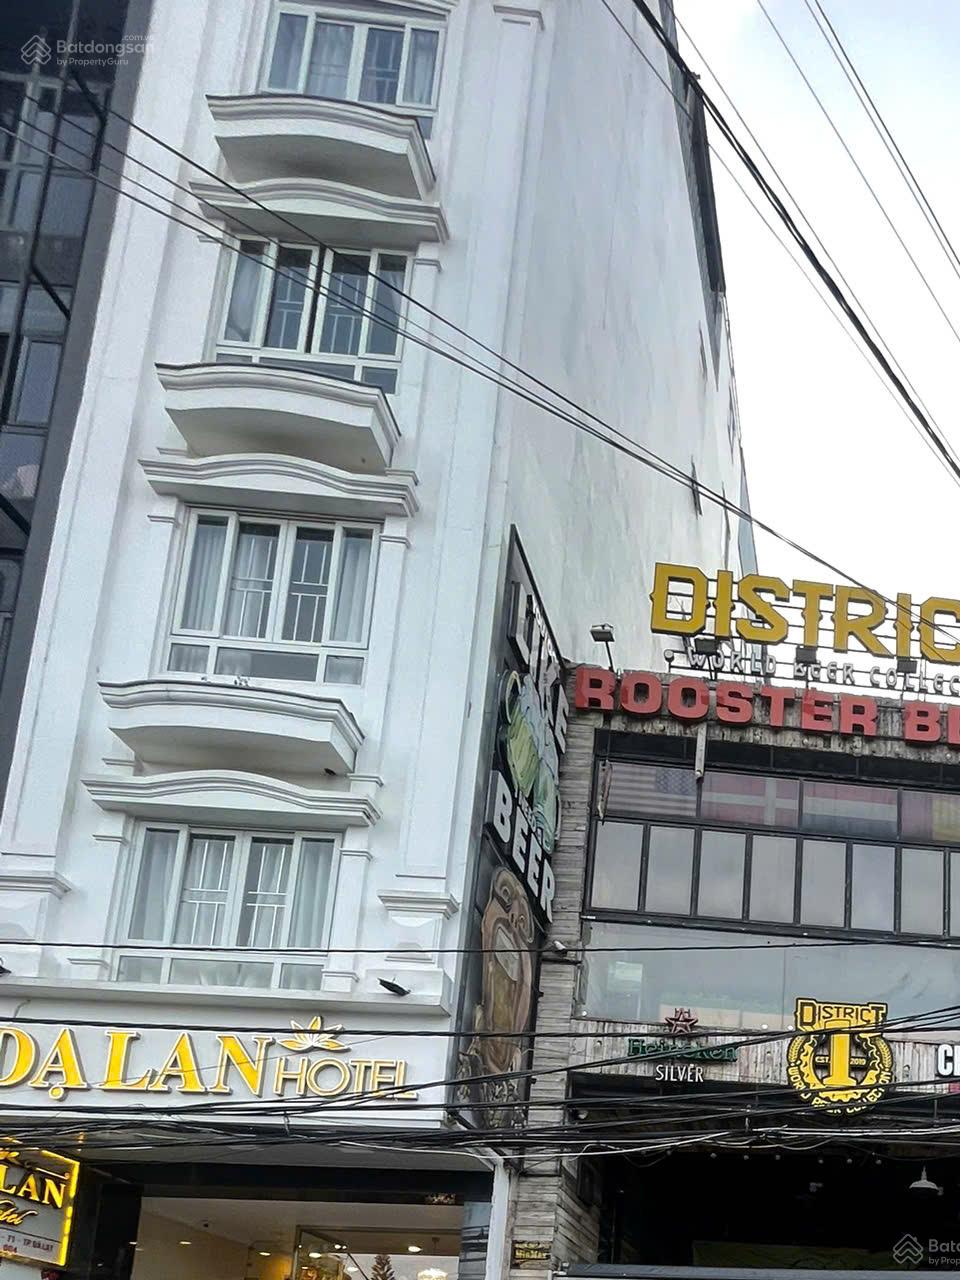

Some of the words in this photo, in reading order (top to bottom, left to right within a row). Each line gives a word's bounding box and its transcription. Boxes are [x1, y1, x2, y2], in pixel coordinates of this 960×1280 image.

[514, 583, 569, 754] LIKE
[688, 646, 777, 676] WORLD
[575, 667, 877, 737] ROOSTER
[492, 770, 556, 924] BEER
[798, 1000, 885, 1028] DISTRICT
[0, 1026, 90, 1101] DẠ
[97, 1030, 274, 1098] LAN
[273, 1056, 419, 1100] HOTEL
[655, 1062, 705, 1083] SILVER
